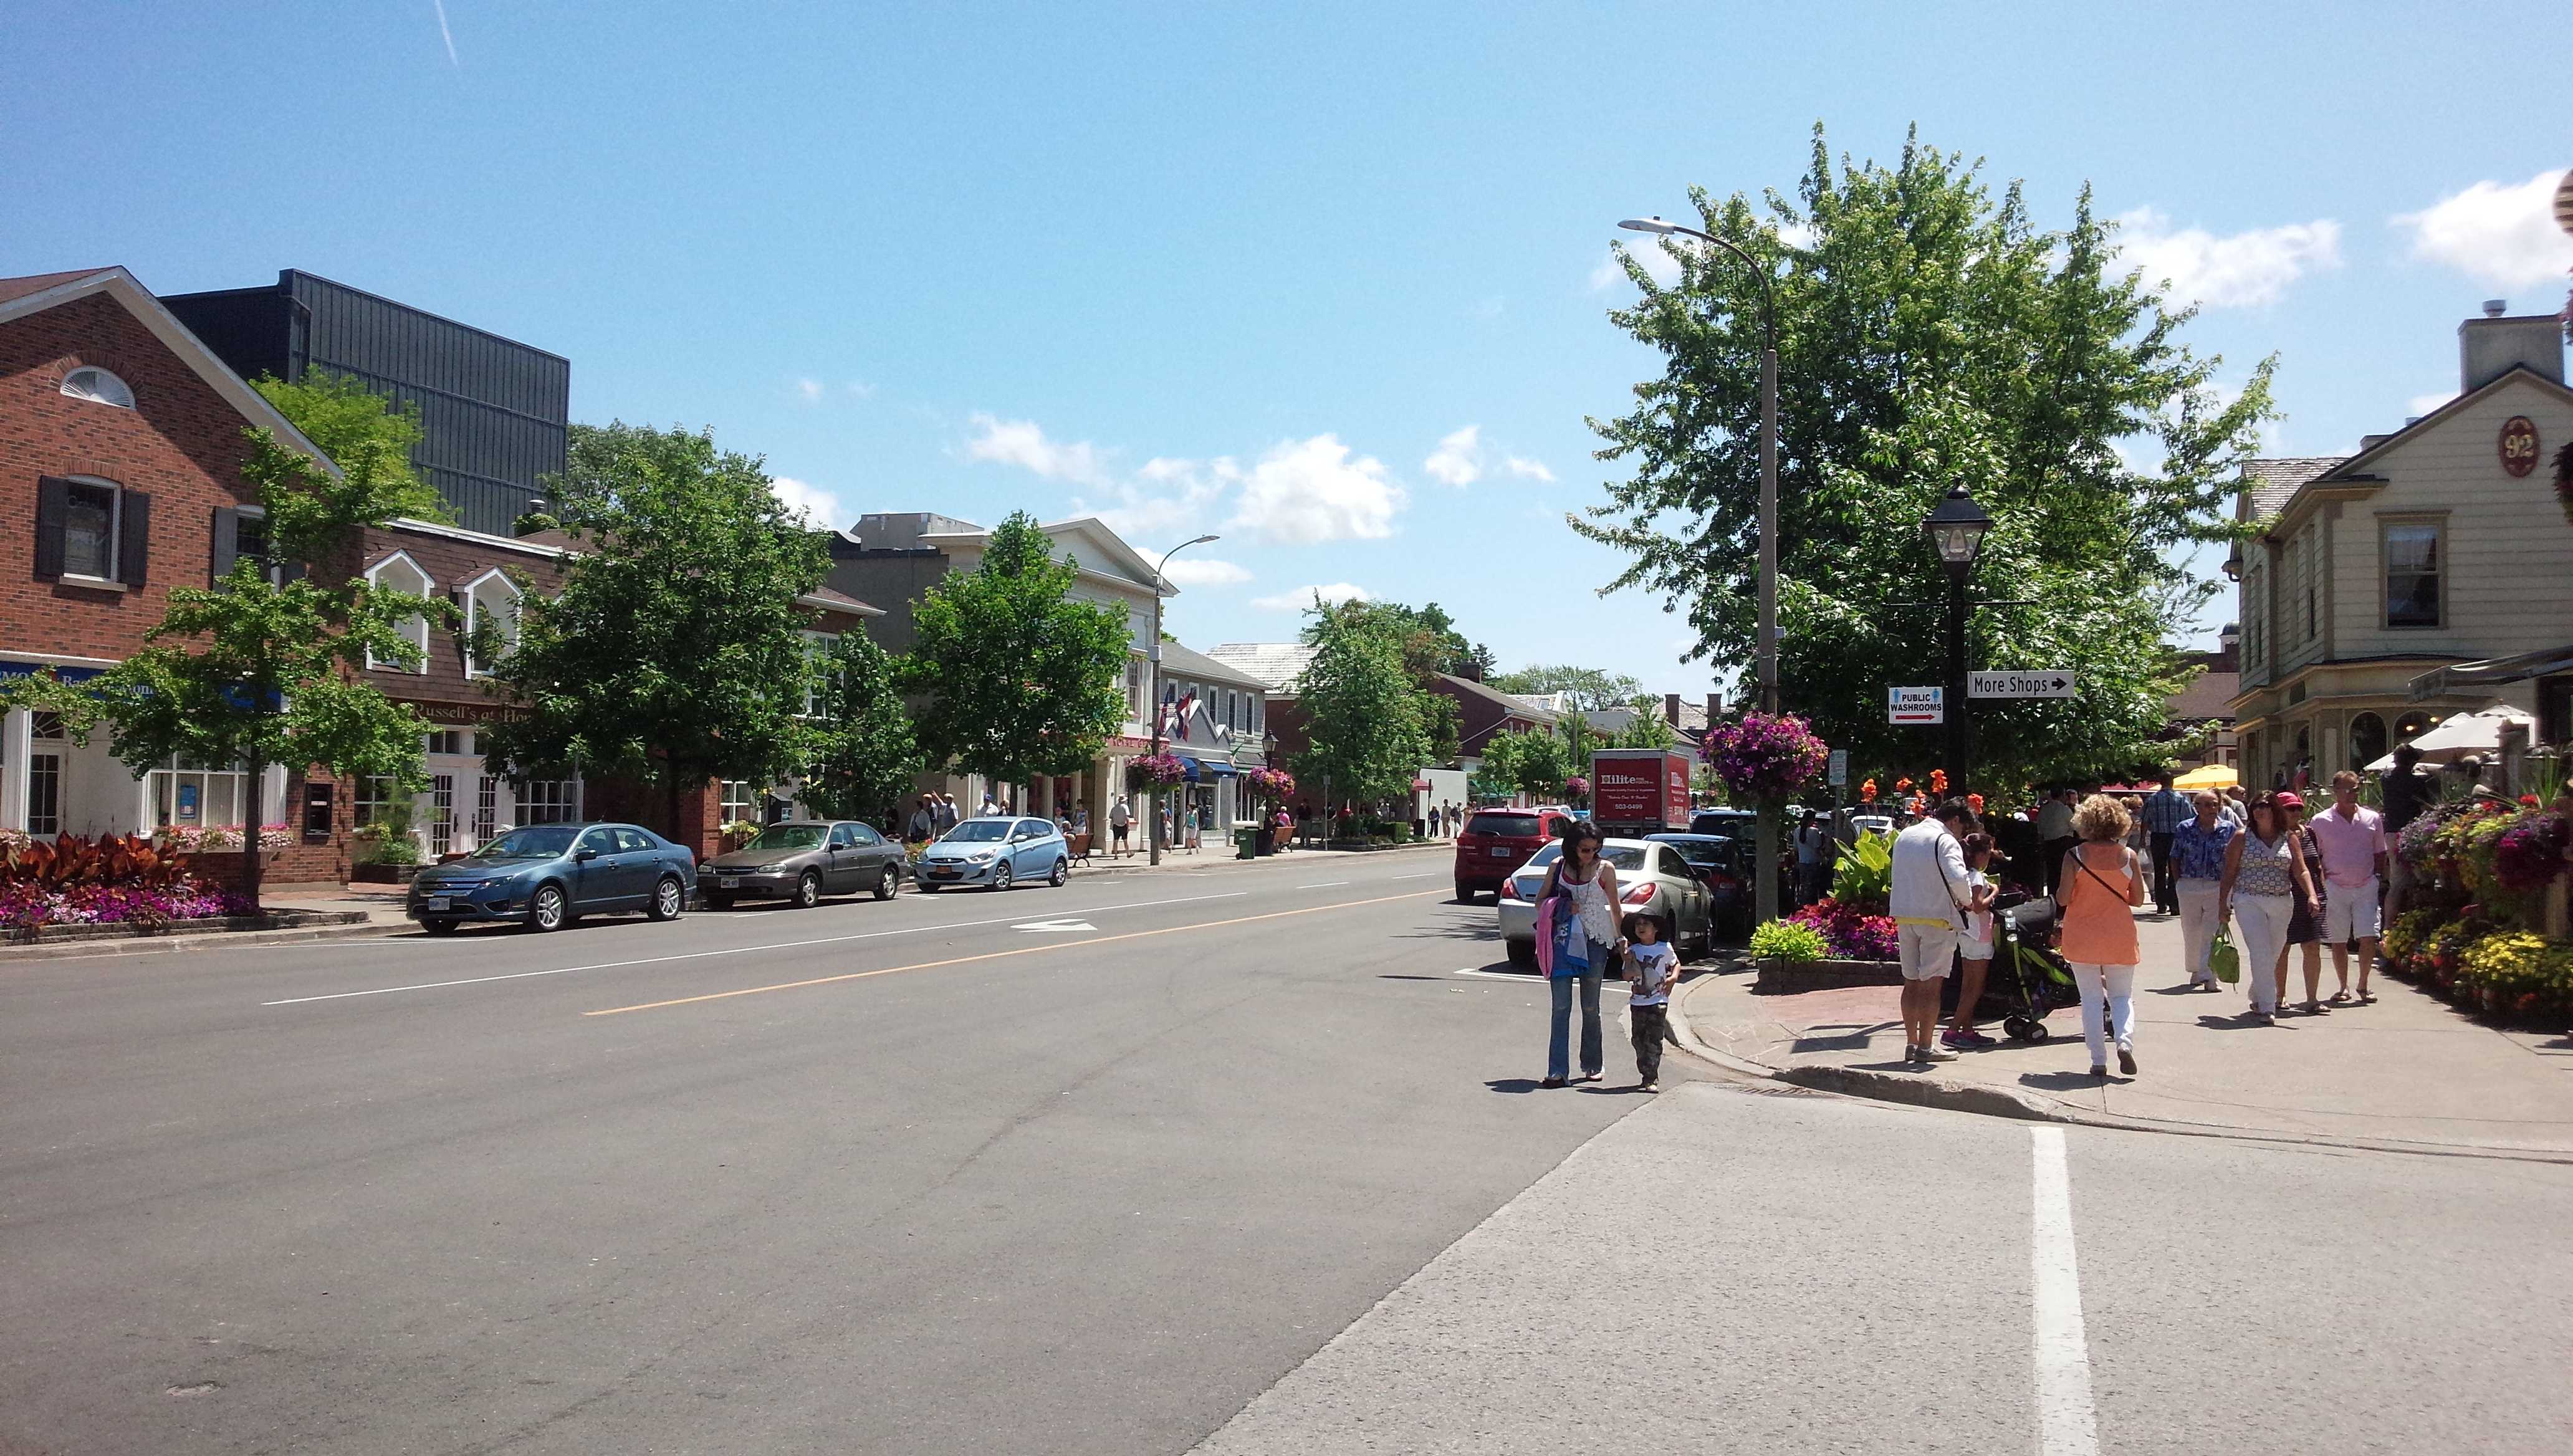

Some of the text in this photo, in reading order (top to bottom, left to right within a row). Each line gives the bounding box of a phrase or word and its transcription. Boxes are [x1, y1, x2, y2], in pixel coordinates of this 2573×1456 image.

[2505, 435, 2534, 458] 92
[1974, 676, 2048, 696] More Shops
[1902, 694, 1930, 702] PUBLIC
[1890, 703, 1942, 711] WASHROOMS
[481, 711, 494, 721] at
